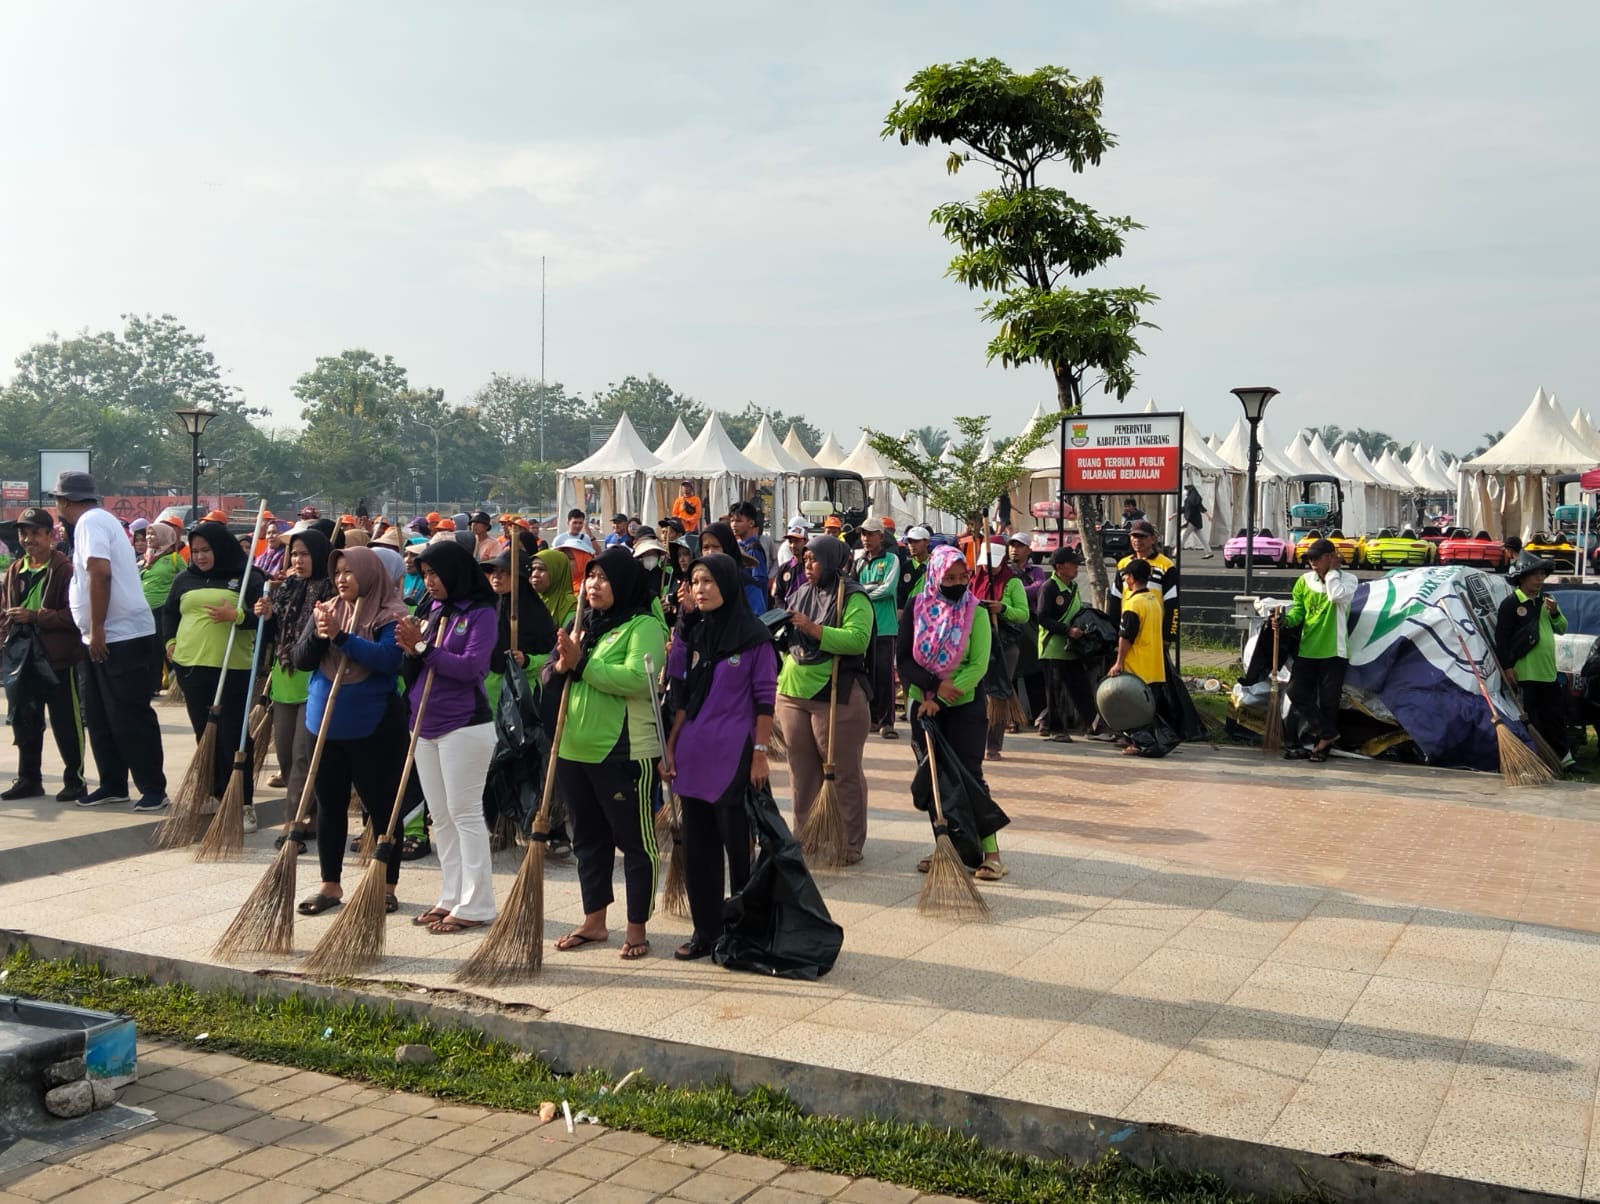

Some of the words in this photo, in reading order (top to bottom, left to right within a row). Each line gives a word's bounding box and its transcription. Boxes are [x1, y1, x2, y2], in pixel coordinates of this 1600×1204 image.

[1114, 424, 1152, 434] PEMERINTAH
[1096, 436, 1130, 446] KABUPATEN
[1135, 435, 1170, 445] TANGERANG
[1078, 457, 1101, 467] RUANG
[1104, 457, 1136, 467] TERBUKA
[1140, 456, 1165, 466] PUBLIK
[1082, 470, 1117, 479] DILARANG
[1120, 469, 1160, 479] BERJUALAN
